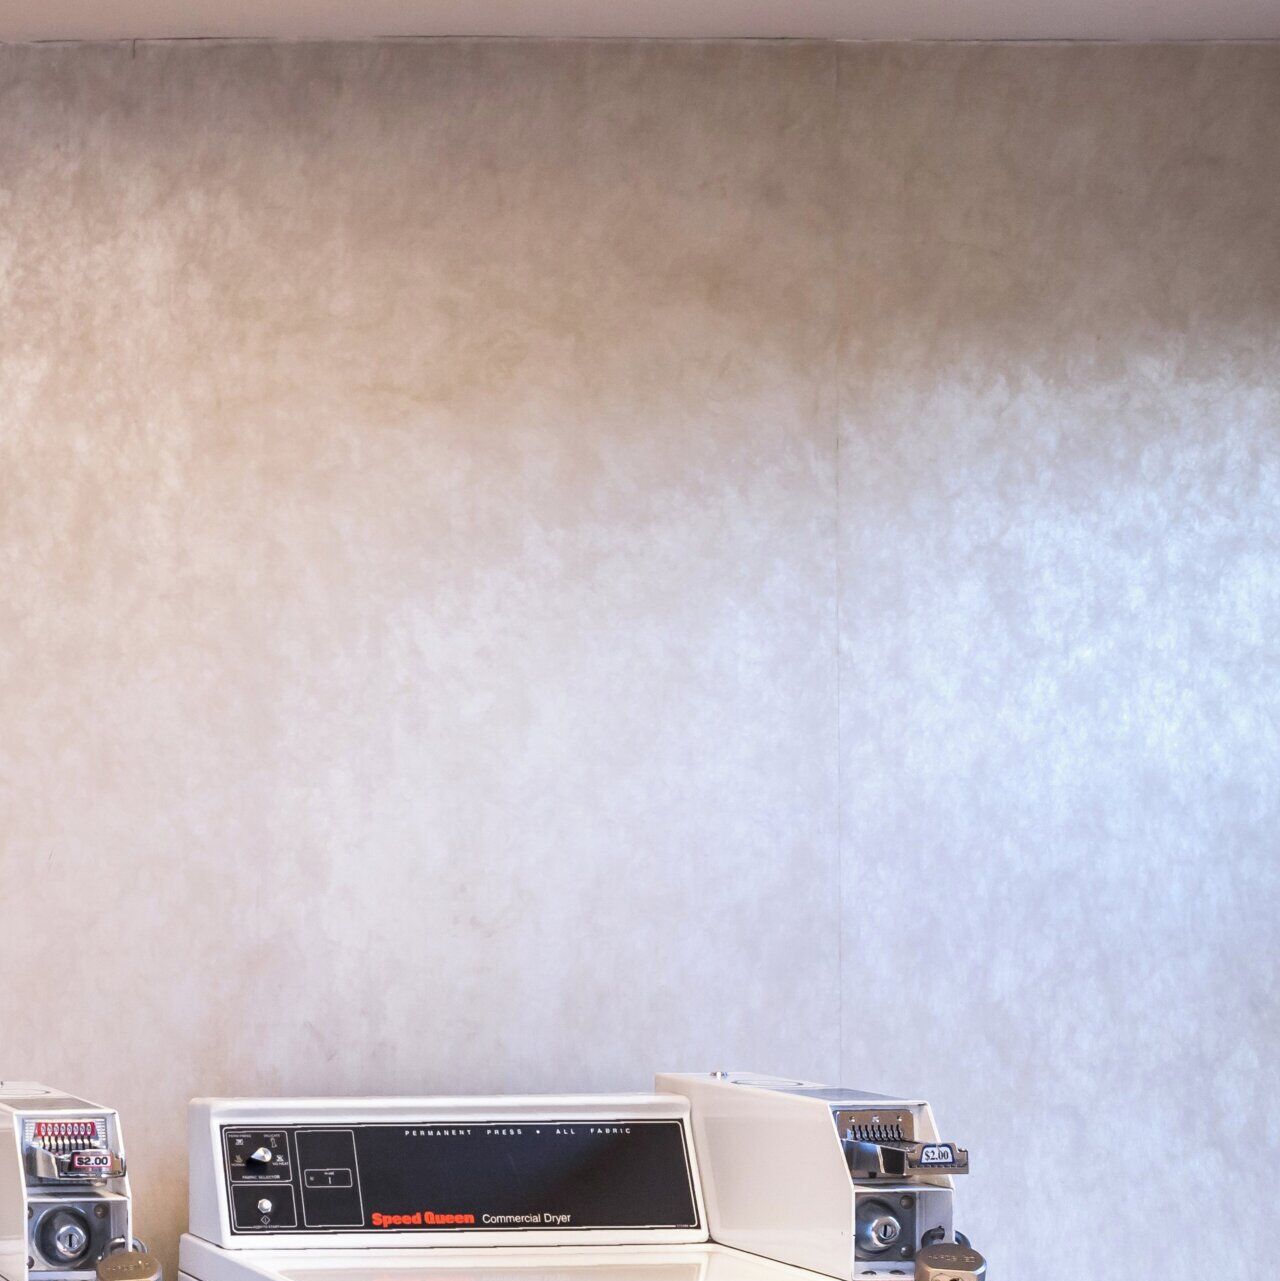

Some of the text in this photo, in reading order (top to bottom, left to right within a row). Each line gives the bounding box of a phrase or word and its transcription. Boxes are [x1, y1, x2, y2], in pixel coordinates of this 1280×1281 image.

[405, 1129, 472, 1137] PERMANENT
[486, 1128, 523, 1136] PRESS
[590, 1127, 632, 1135] FABRIC
[76, 1156, 109, 1166] $2.00
[924, 1150, 949, 1162] $2.00
[371, 1211, 571, 1227] Speed Queen Commercial Dryer
